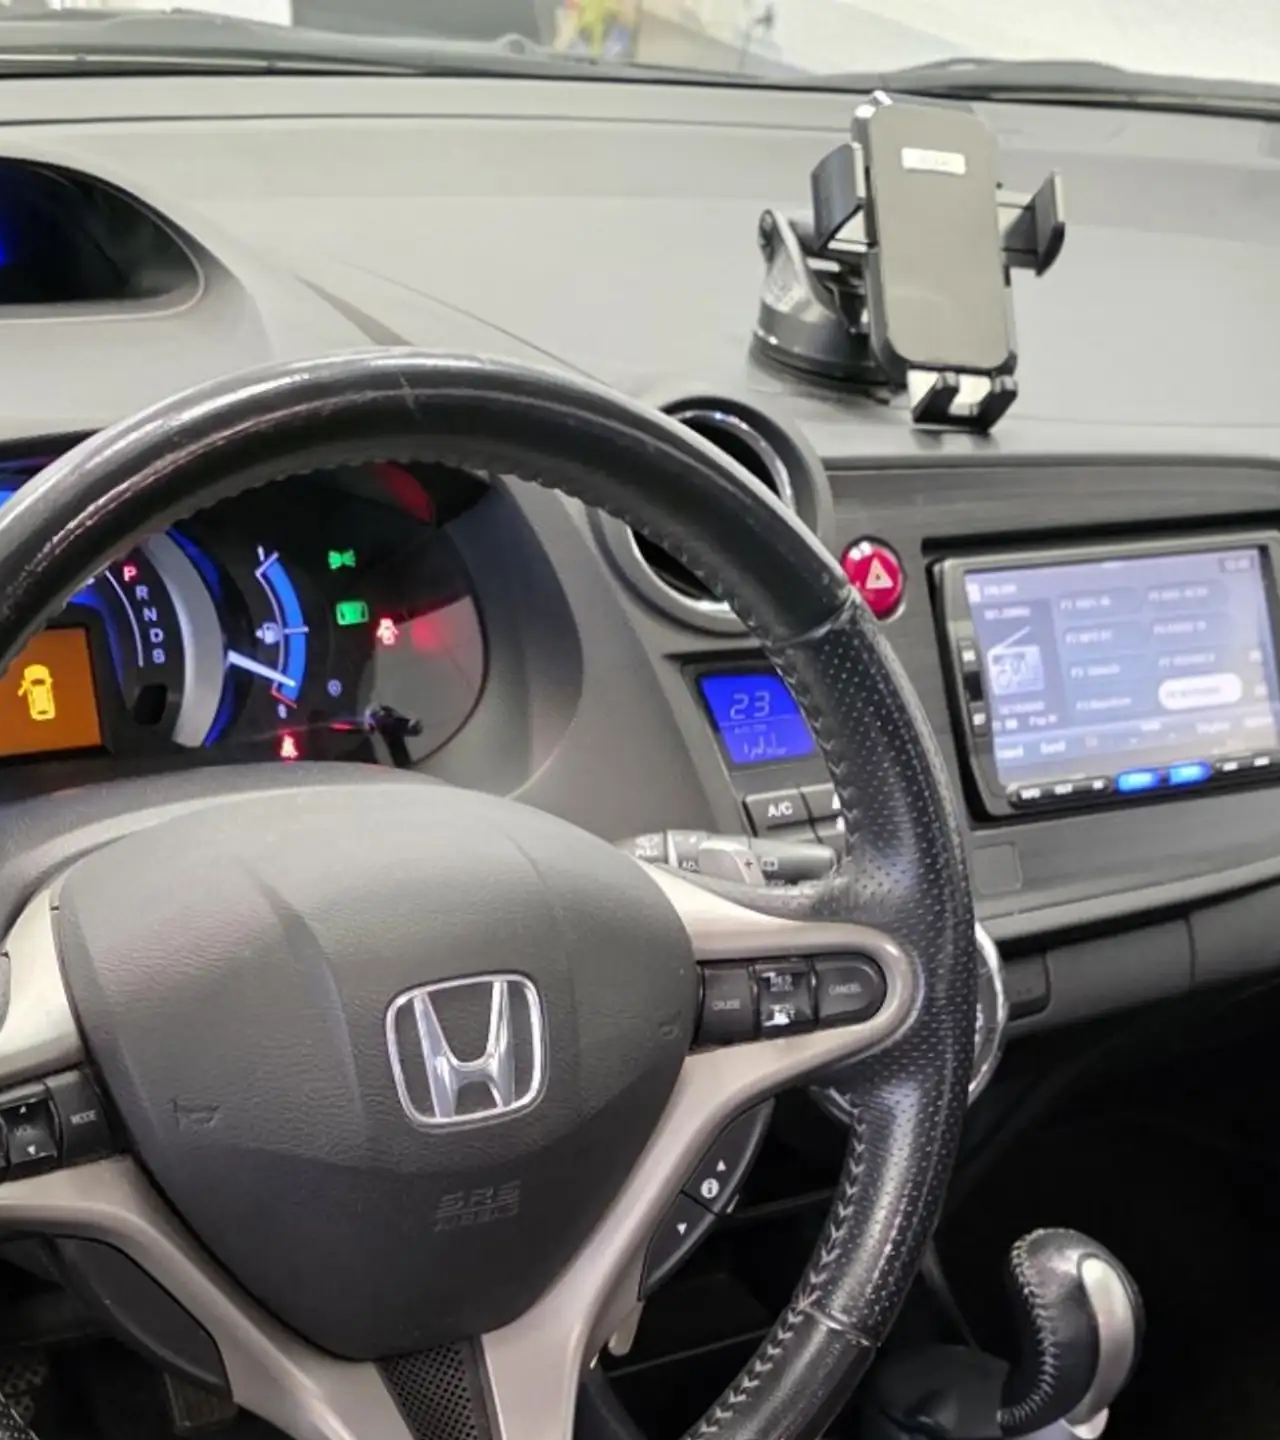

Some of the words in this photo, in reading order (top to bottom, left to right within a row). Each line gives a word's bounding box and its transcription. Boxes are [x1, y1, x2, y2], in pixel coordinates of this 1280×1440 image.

[123, 565, 138, 582] P
[135, 584, 150, 601] R
[143, 605, 158, 622] N
[149, 627, 165, 644] D
[729, 692, 771, 721] 23
[767, 801, 794, 818] A/C
[69, 1109, 97, 1125] MODE
